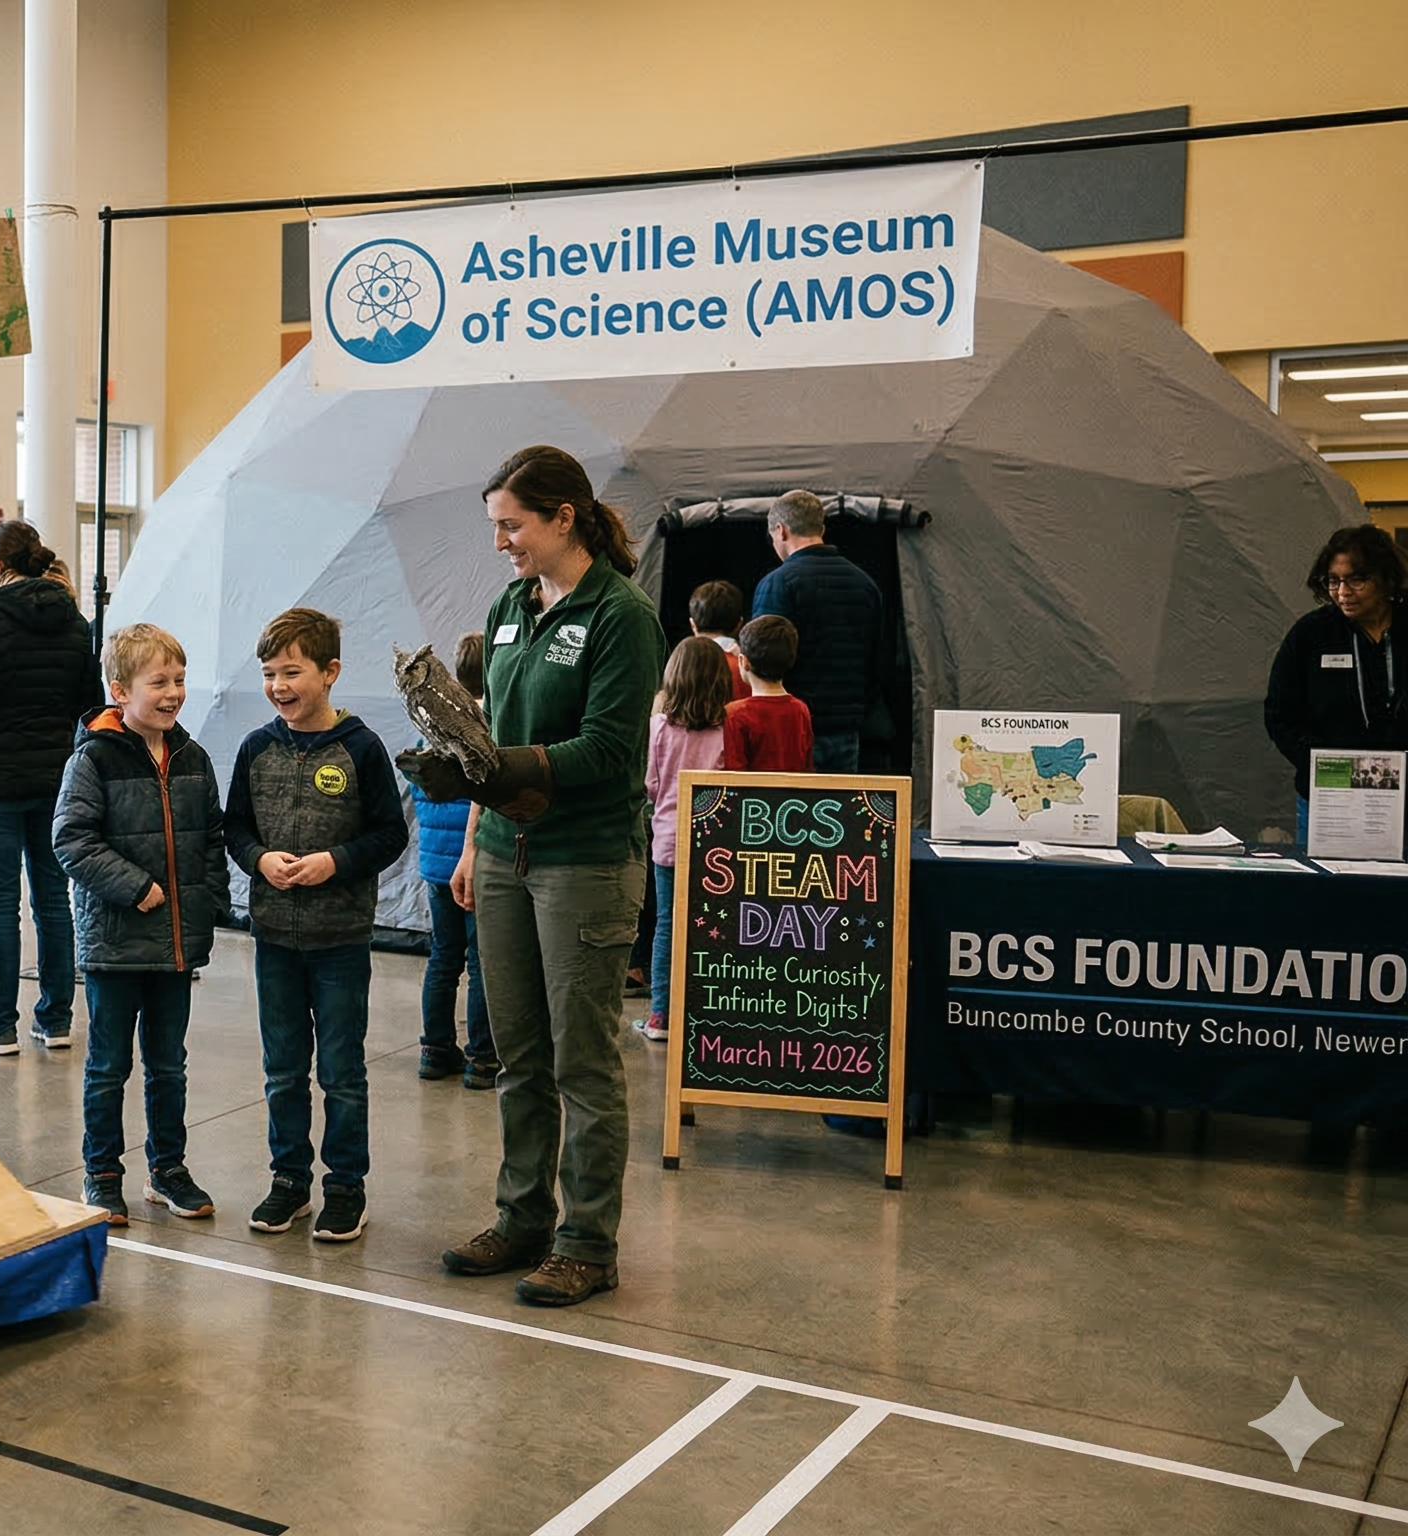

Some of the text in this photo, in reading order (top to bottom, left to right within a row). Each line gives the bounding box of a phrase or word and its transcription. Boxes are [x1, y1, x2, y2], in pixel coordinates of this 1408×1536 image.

[461, 213, 954, 283] Asheville Museum
[462, 265, 954, 344] of Science (AMOS)
[981, 718, 1069, 729] BCS FOUNDATION
[741, 798, 844, 847] BCS
[702, 847, 877, 902] STEAM
[739, 902, 839, 950] DAY
[692, 952, 885, 998] Infinite Curiosity,
[949, 931, 1407, 1003] BCS FOUNDATIO
[702, 985, 868, 1027] Infinite Digits!
[948, 1001, 1085, 1034] Buncombe
[1096, 1012, 1191, 1046] County
[1200, 1018, 1304, 1052] School,
[701, 1034, 771, 1067] March
[811, 1042, 872, 1074] 2026
